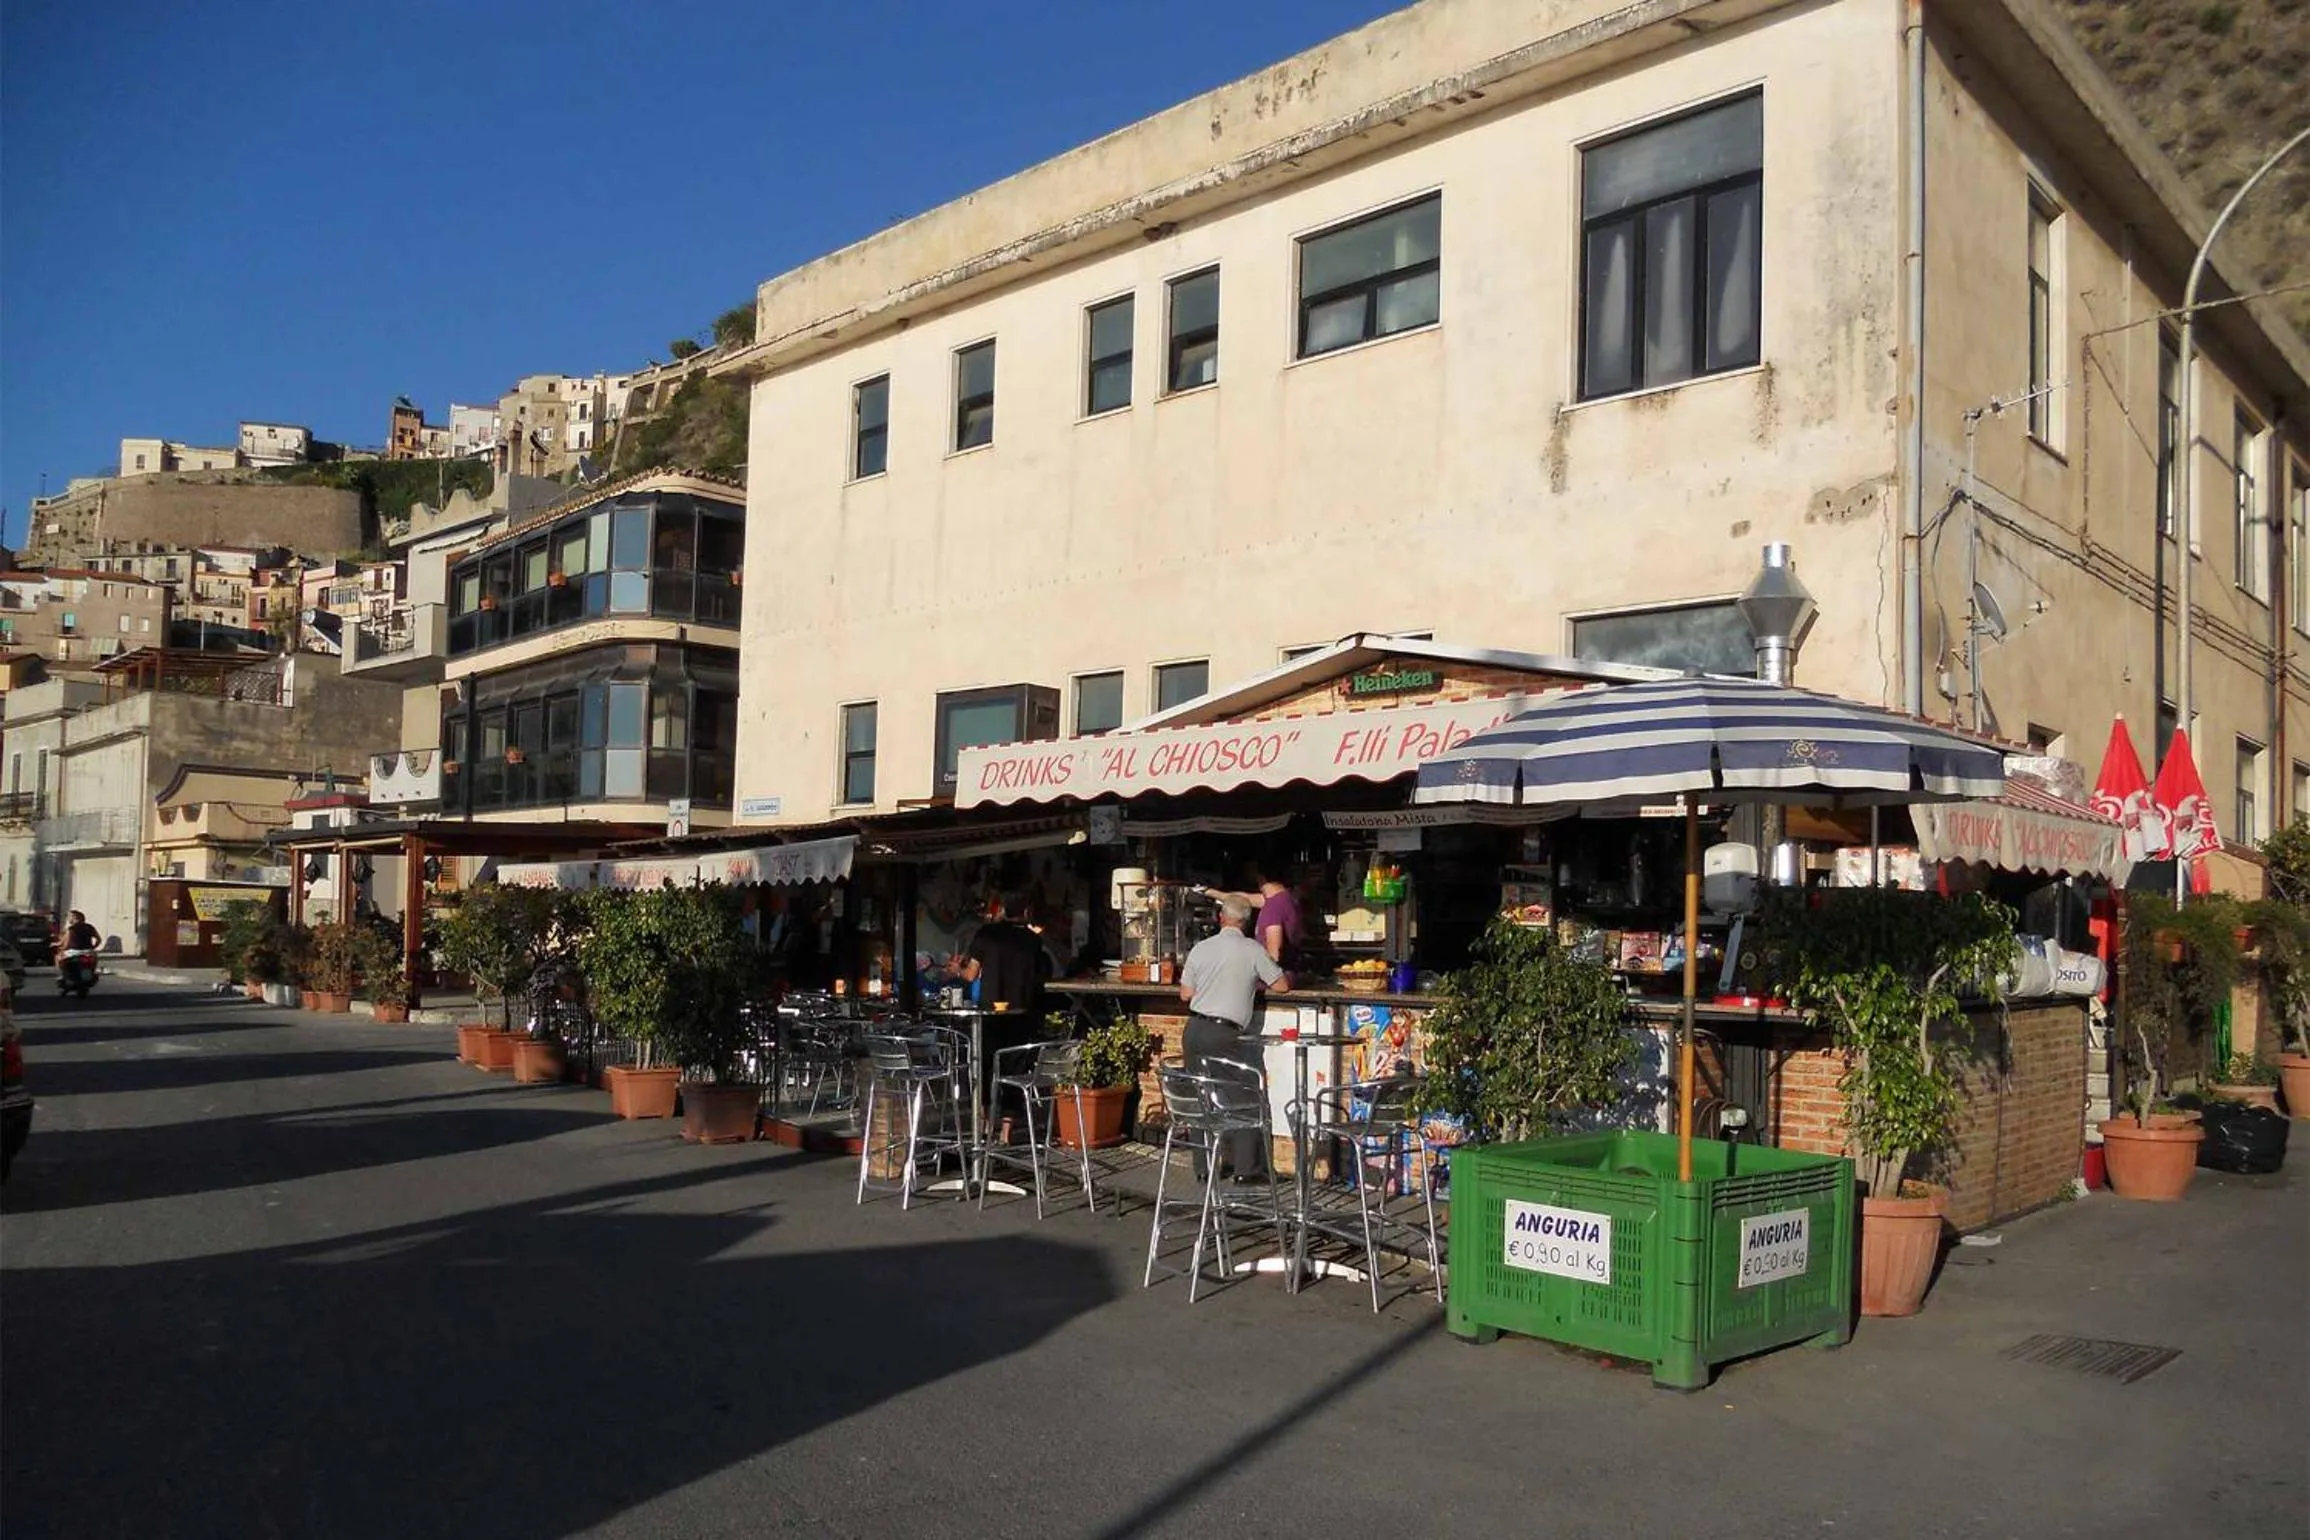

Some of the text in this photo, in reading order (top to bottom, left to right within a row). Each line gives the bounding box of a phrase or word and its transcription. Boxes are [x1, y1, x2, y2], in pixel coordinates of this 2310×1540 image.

[1354, 671, 1433, 693] Heineken
[980, 754, 1075, 791] DRINKS
[1149, 731, 1301, 778] CHIOSCO"
[1515, 1211, 1600, 1243] ANGURIA
[1749, 1219, 1803, 1250] ANGURIA
[1508, 1240, 1606, 1278] € 0,90 al Kg
[1743, 1258, 1752, 1277] €
